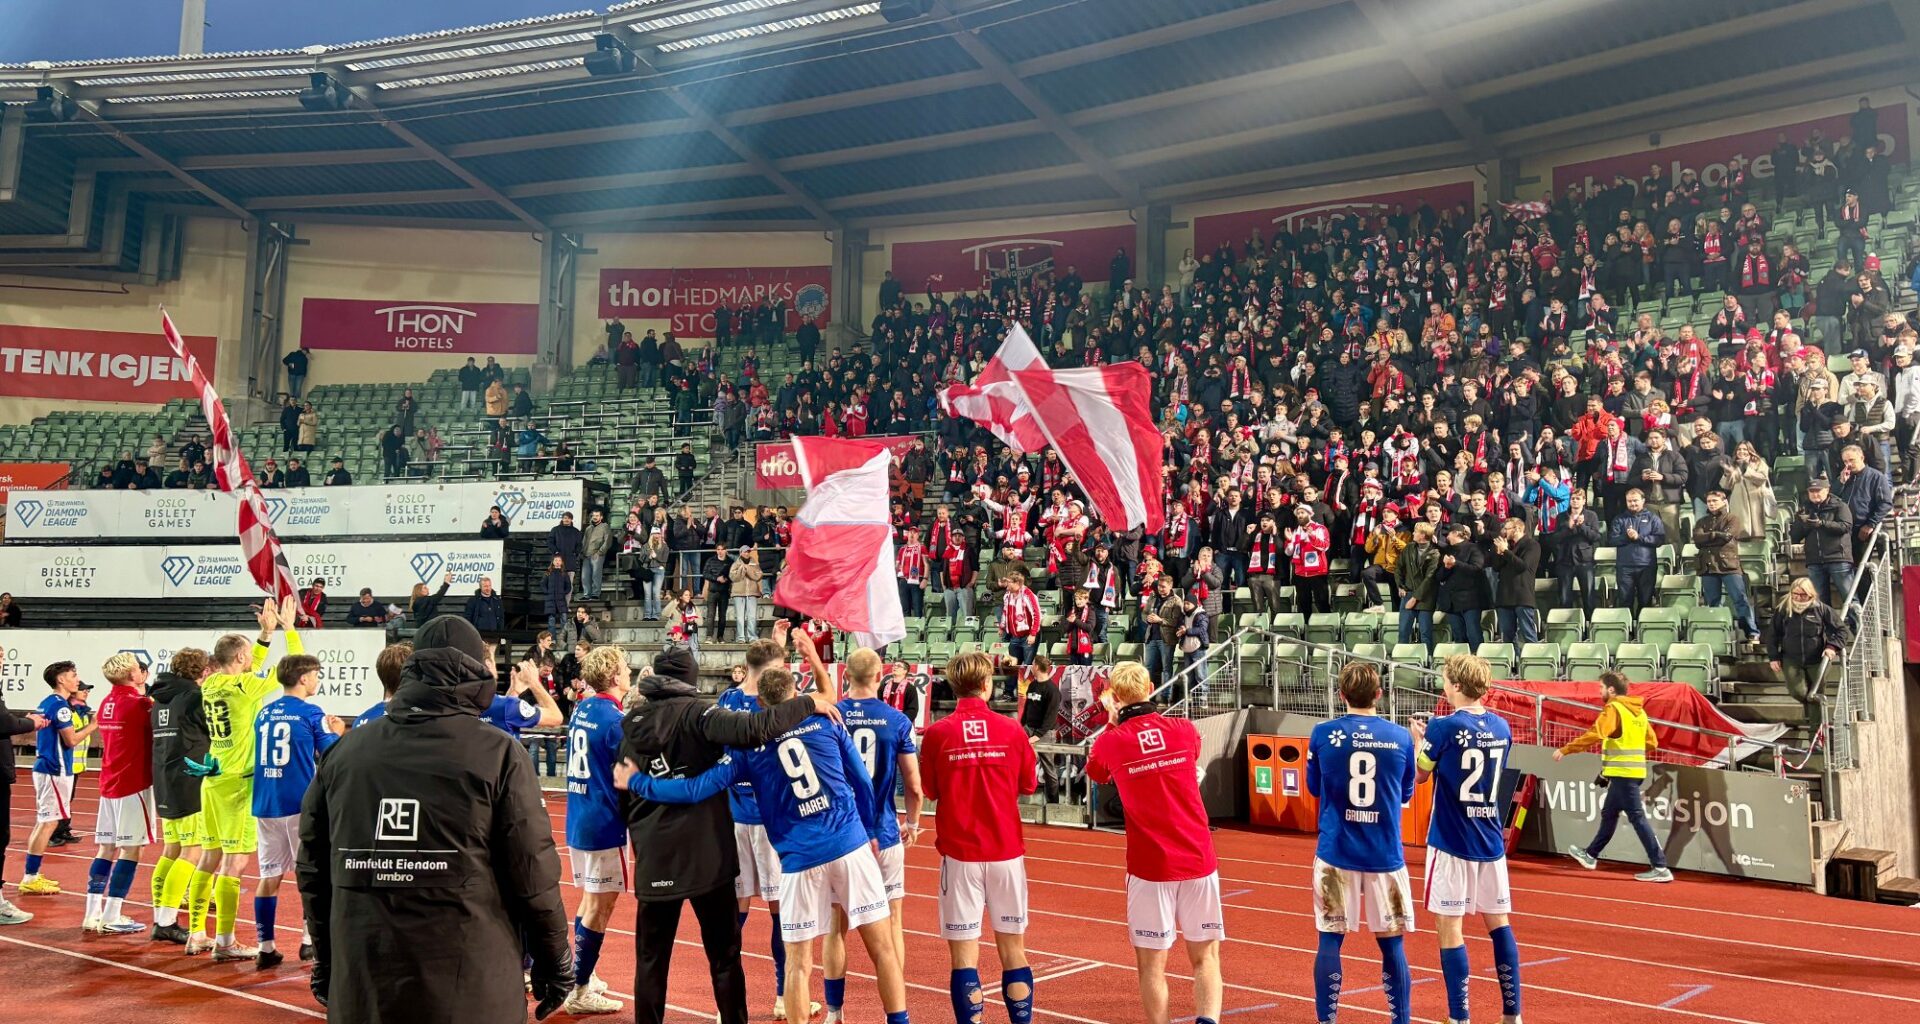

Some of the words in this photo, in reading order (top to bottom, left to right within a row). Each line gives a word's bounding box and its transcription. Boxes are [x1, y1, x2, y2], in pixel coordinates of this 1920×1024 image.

[375, 305, 477, 334] THON
[395, 337, 454, 349] HOTELS
[1, 348, 95, 377] TENK
[99, 354, 193, 387] IGJEN
[761, 455, 803, 476] tho
[157, 499, 186, 507] OSLO
[397, 494, 426, 503] OSLO
[385, 505, 435, 514] BISLETT
[529, 500, 575, 509] DIAMOND
[45, 508, 87, 516] DIAMOND
[145, 509, 196, 518] BISLETT
[289, 506, 330, 514] DIAMOND
[526, 511, 564, 519] LEAGUE
[42, 518, 78, 526] LEAGUE
[148, 519, 192, 527] GAMES
[287, 516, 321, 524] LEAGUE
[389, 515, 431, 524] GAMES
[54, 556, 85, 566] OSLO
[306, 554, 336, 564] OSLO
[196, 565, 242, 574] DIAMOND
[293, 565, 347, 575] BISLETT
[446, 562, 495, 571] DIAMOND
[41, 567, 96, 577] BISLETT
[45, 578, 91, 588] GAMES
[194, 576, 232, 585] LEAGUE
[297, 577, 342, 586] GAES
[448, 574, 484, 583] EAGUE
[317, 650, 354, 663] OSLO
[319, 667, 370, 680] SLETT
[317, 683, 363, 696] AMES
[846, 718, 887, 728] Sparebank
[260, 722, 291, 766] 13
[1352, 740, 1399, 749] Sparebank
[567, 726, 591, 779] 18
[778, 738, 820, 799] 9
[1349, 751, 1376, 807] 8
[1460, 748, 1504, 802] 27
[798, 796, 830, 817] HAREN
[380, 799, 412, 831] RE
[1345, 809, 1379, 823] GRUNDT
[345, 858, 393, 869] Rimfeldt
[396, 858, 448, 870] Eiendom
[377, 872, 414, 882] umbro
[651, 880, 674, 888] umbro
